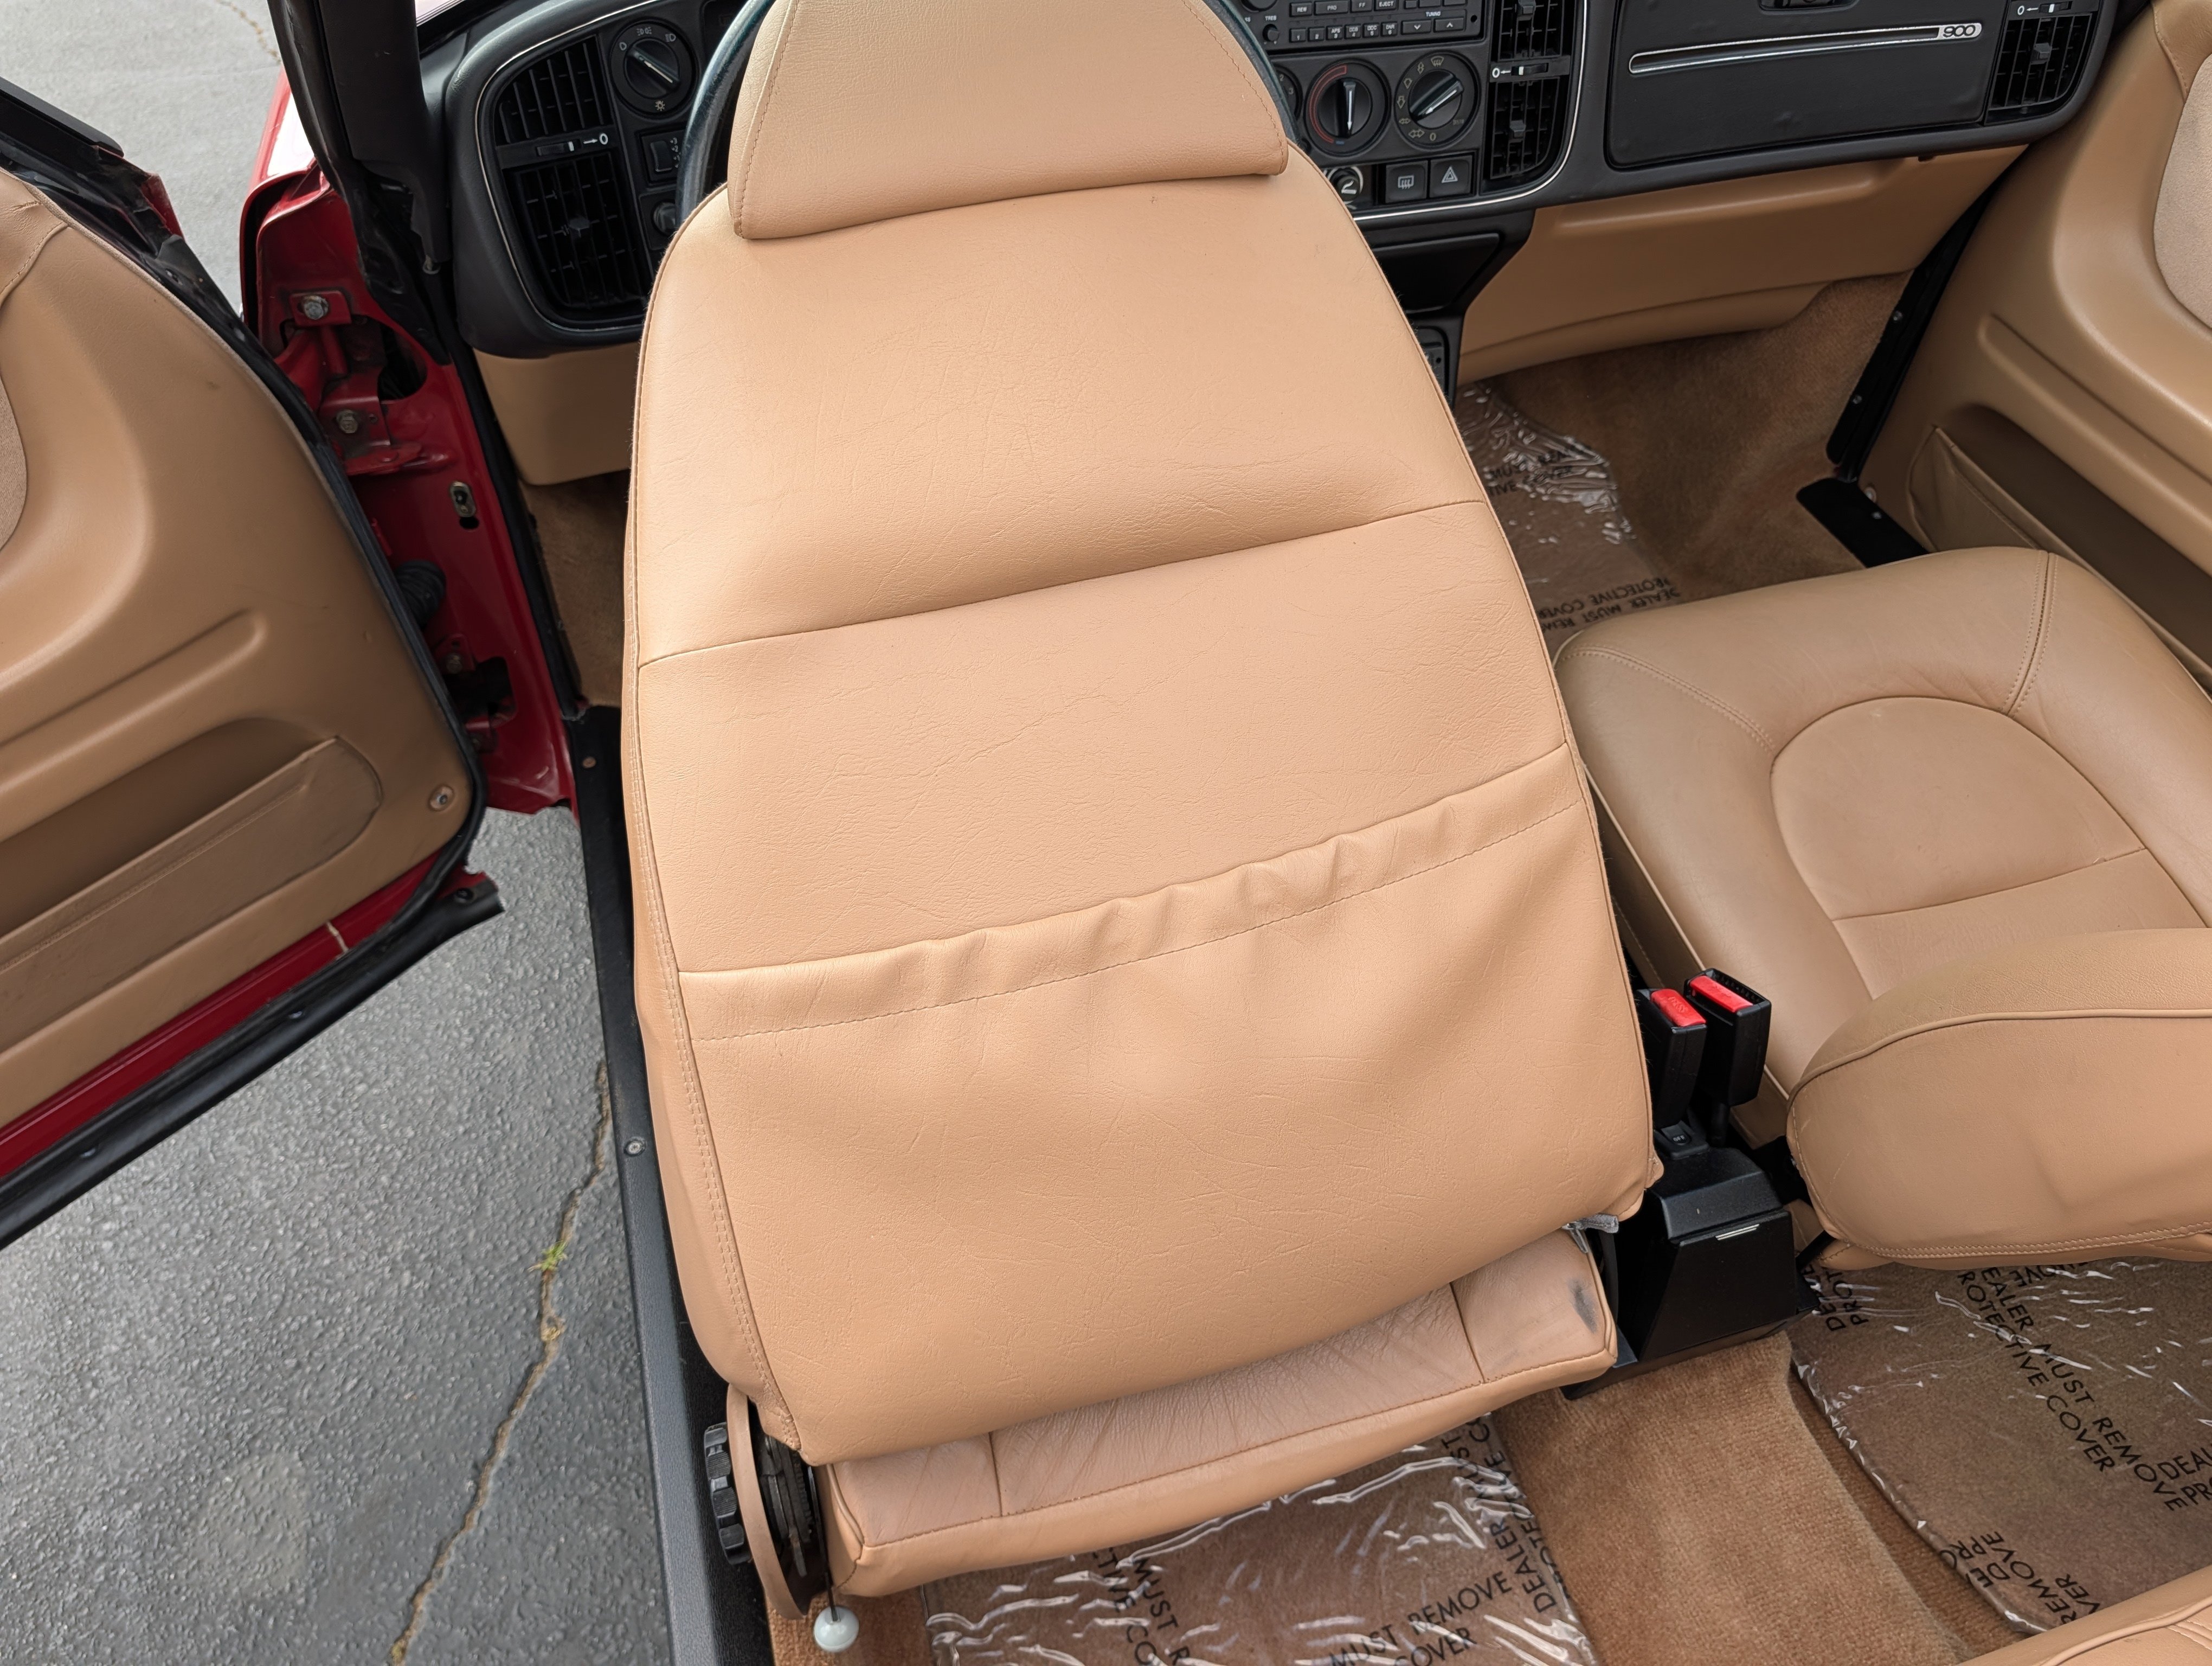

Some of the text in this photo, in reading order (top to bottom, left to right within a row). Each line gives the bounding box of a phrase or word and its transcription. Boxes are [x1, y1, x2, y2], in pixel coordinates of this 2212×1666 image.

[1943, 24, 1976, 39] 900
[1582, 604, 1621, 623] MUST
[2046, 1394, 2115, 1472] COVER
[2092, 1417, 2189, 1511] REMOVE
[2180, 1477, 2212, 1505] PR
[1489, 1517, 1557, 1614] DEALER
[1407, 1571, 1513, 1636] REMOVE
